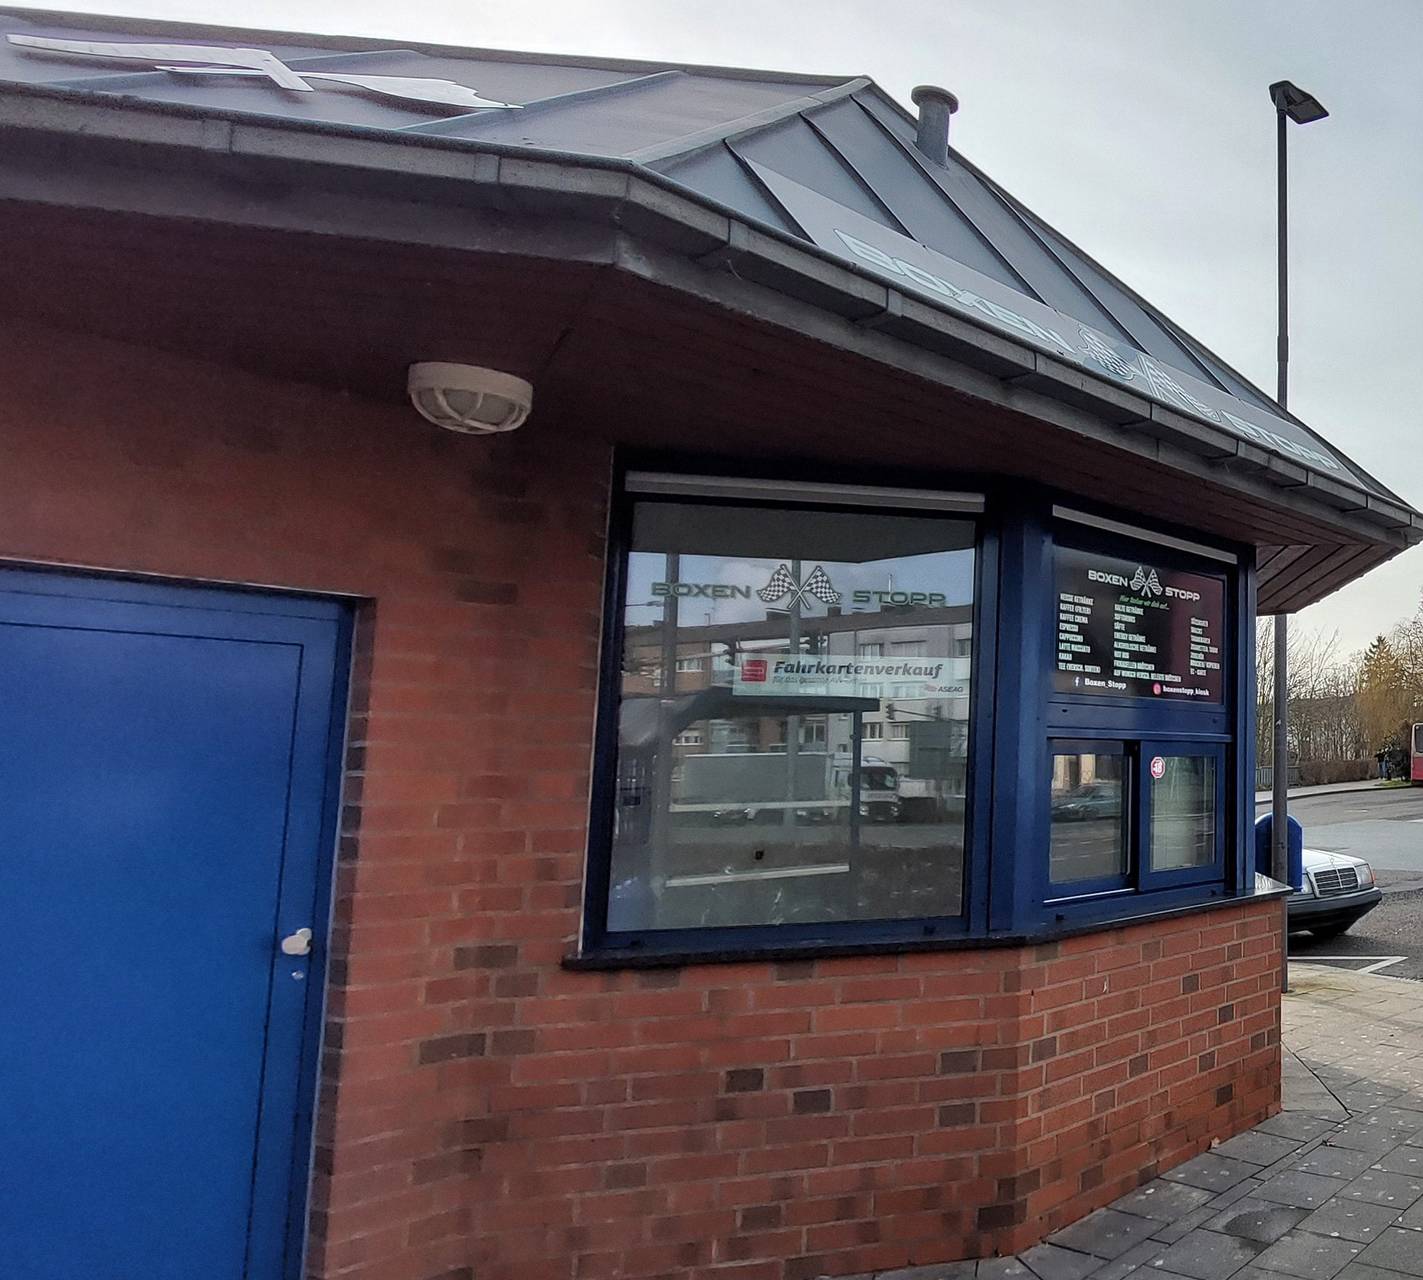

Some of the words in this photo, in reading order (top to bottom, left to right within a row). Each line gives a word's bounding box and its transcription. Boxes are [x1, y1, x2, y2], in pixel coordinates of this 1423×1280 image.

[833, 228, 1077, 355] BOXEN
[1220, 409, 1340, 470] STOPP
[651, 582, 751, 599] BOXEN
[853, 590, 947, 606] STOPP
[1088, 569, 1128, 587] BOXEN
[1165, 586, 1201, 601] STOPP
[773, 660, 944, 679] Fahrkartenverkauf
[1084, 678, 1127, 690] Boxen_Stopp
[1162, 684, 1210, 697] boxenstopp_kiosk
